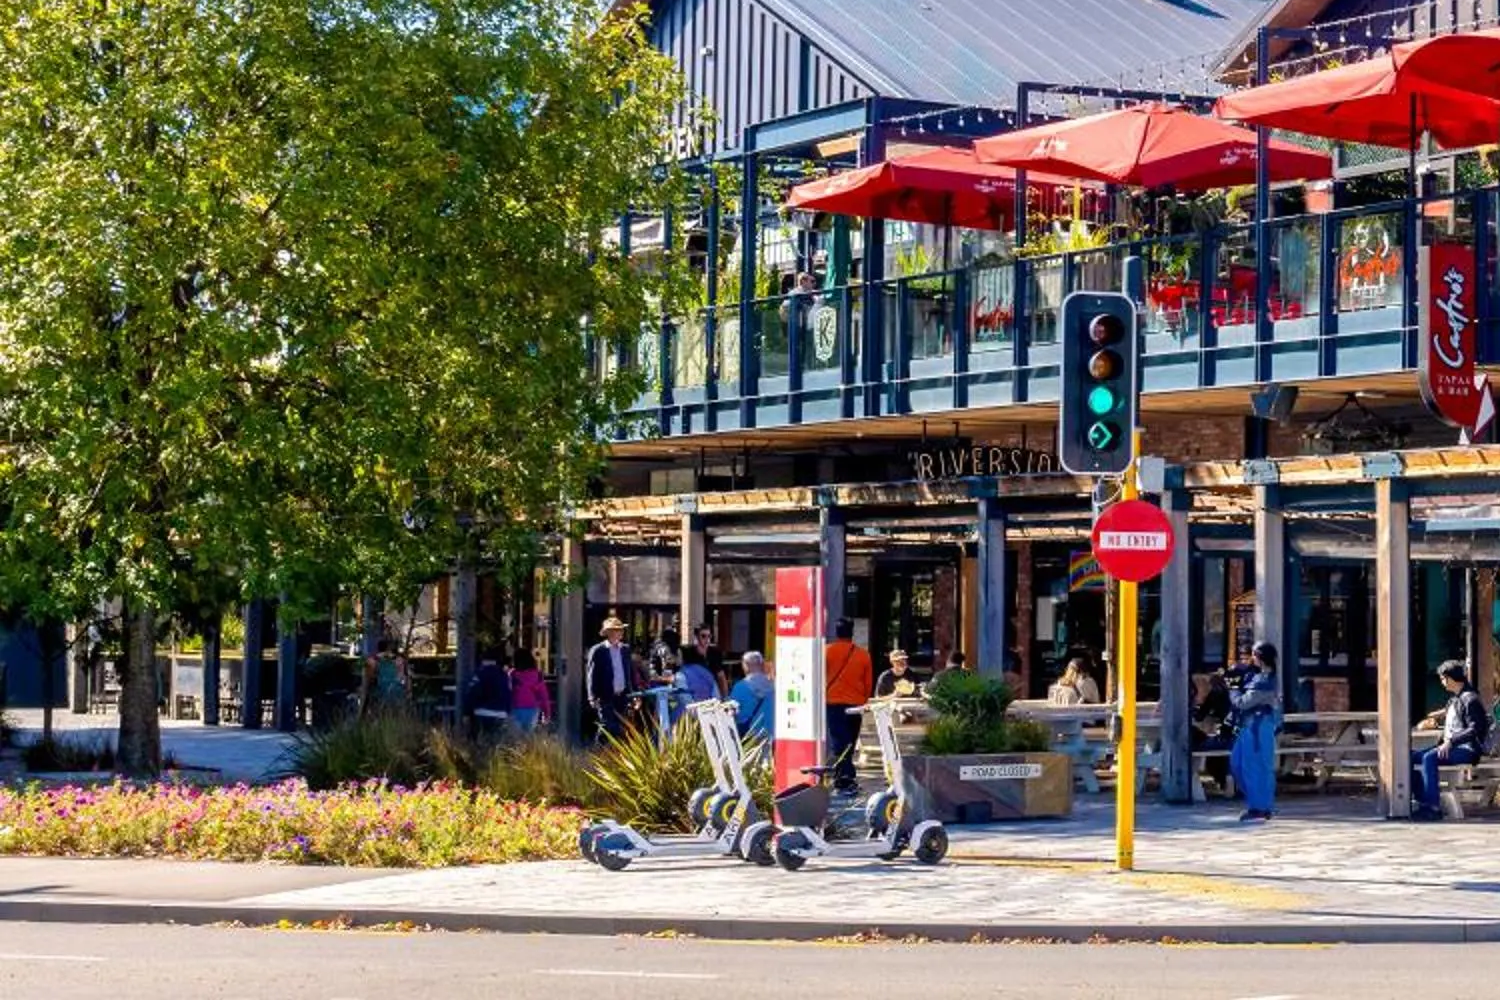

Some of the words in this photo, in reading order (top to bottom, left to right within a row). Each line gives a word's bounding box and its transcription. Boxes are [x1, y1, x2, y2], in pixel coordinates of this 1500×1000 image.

[918, 447, 1062, 480] RIVERSID
[1107, 535, 1121, 547] NO
[1127, 535, 1160, 547] ENTRY
[971, 767, 997, 777] ROAD
[999, 765, 1031, 777] CLOSED
